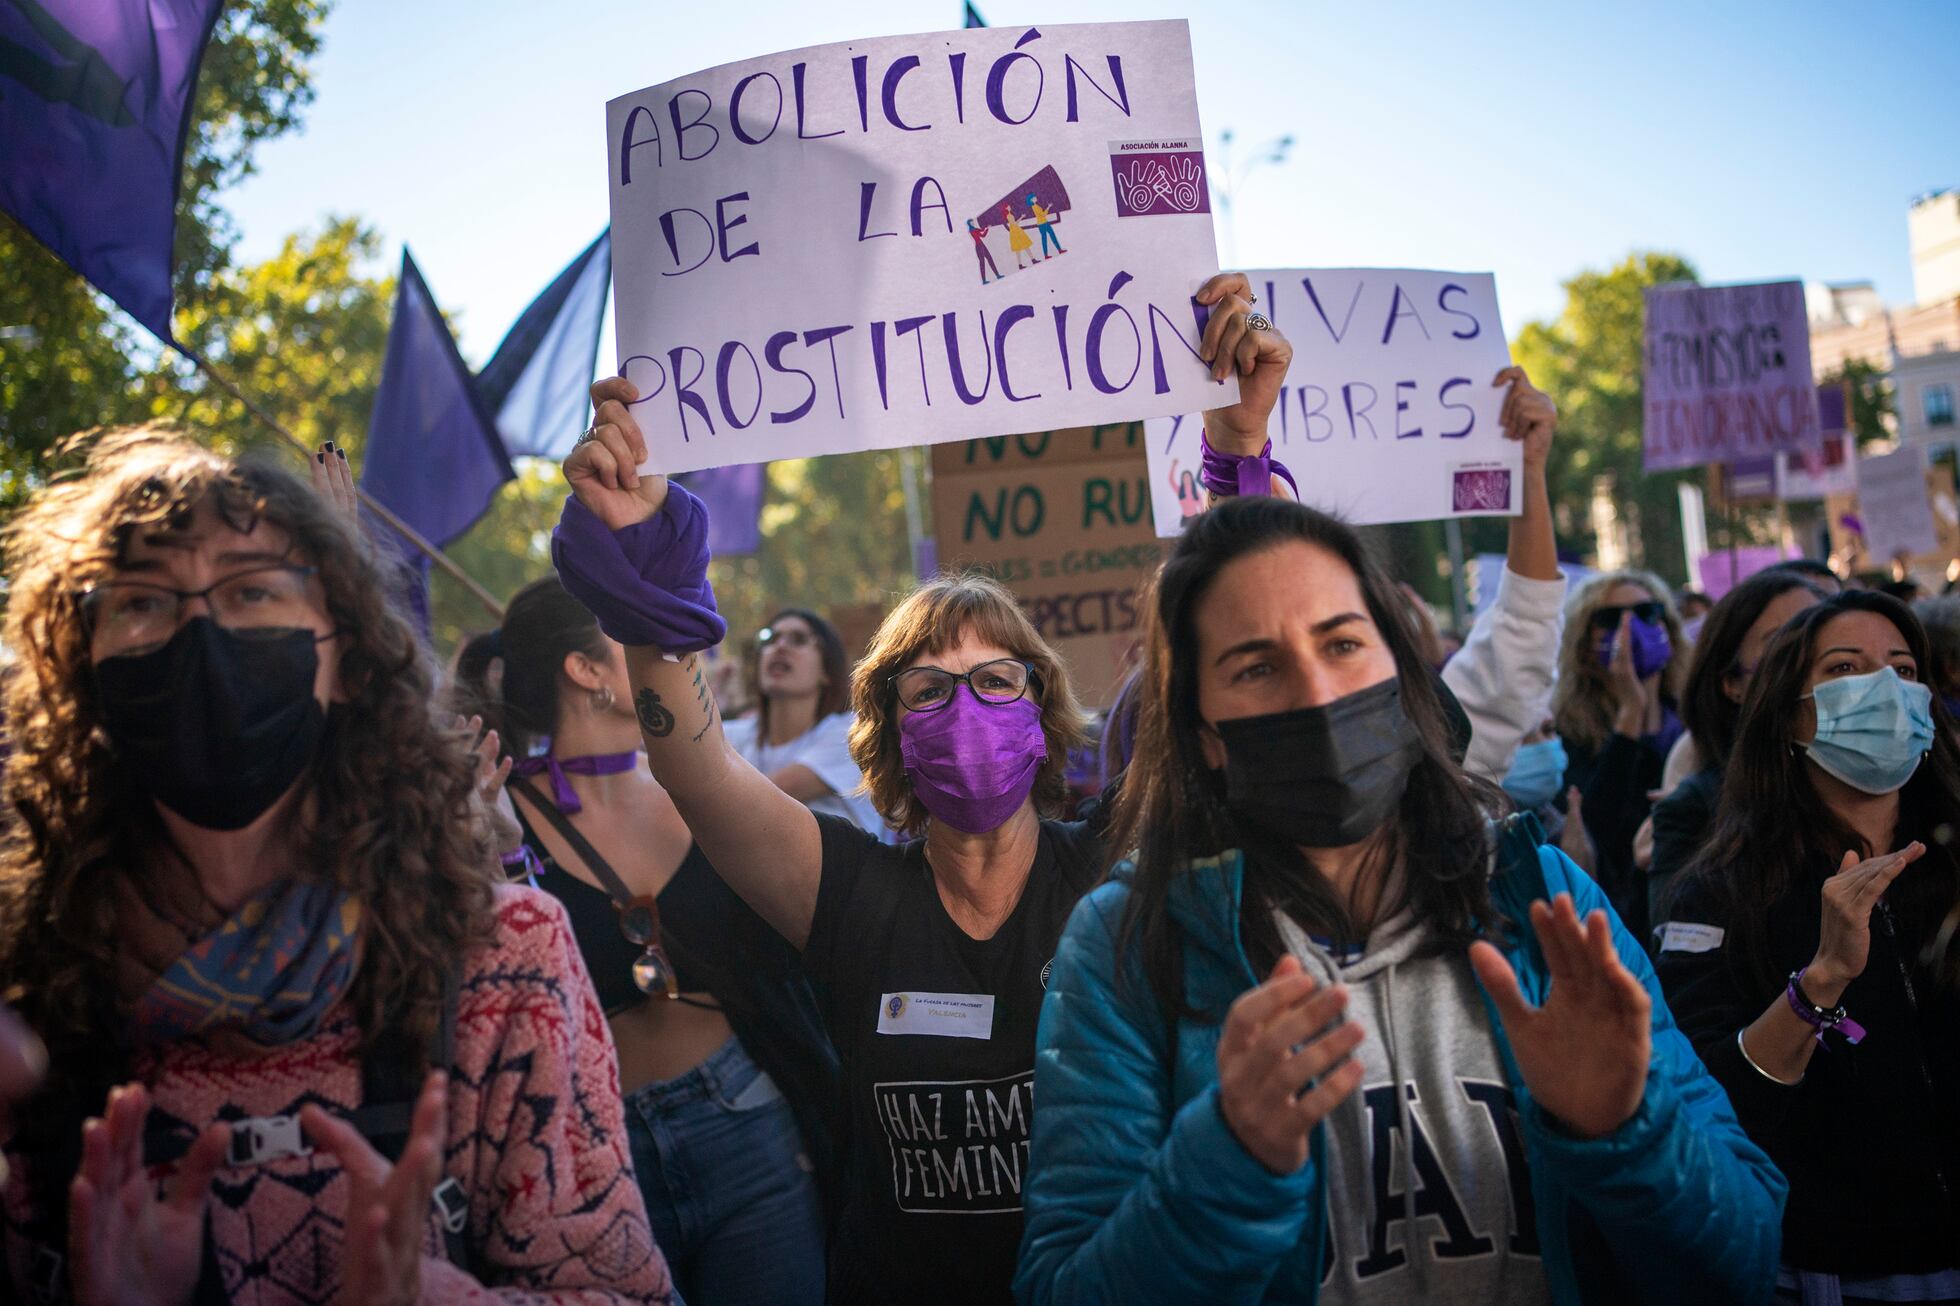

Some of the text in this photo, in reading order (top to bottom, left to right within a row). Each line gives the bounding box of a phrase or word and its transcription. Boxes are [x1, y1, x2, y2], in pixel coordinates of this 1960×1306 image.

[621, 27, 1130, 186] ABOLICIÓN
[1120, 141, 1188, 151] ASOCIACIÓN ALANNA
[659, 176, 954, 276] DE LA
[1265, 278, 1481, 345] IVAS
[618, 270, 1226, 443] PROSTITUCIÓN
[1279, 376, 1477, 446] IBRES
[963, 476, 1155, 543] NO RU
[884, 1093, 948, 1141] HAZ
